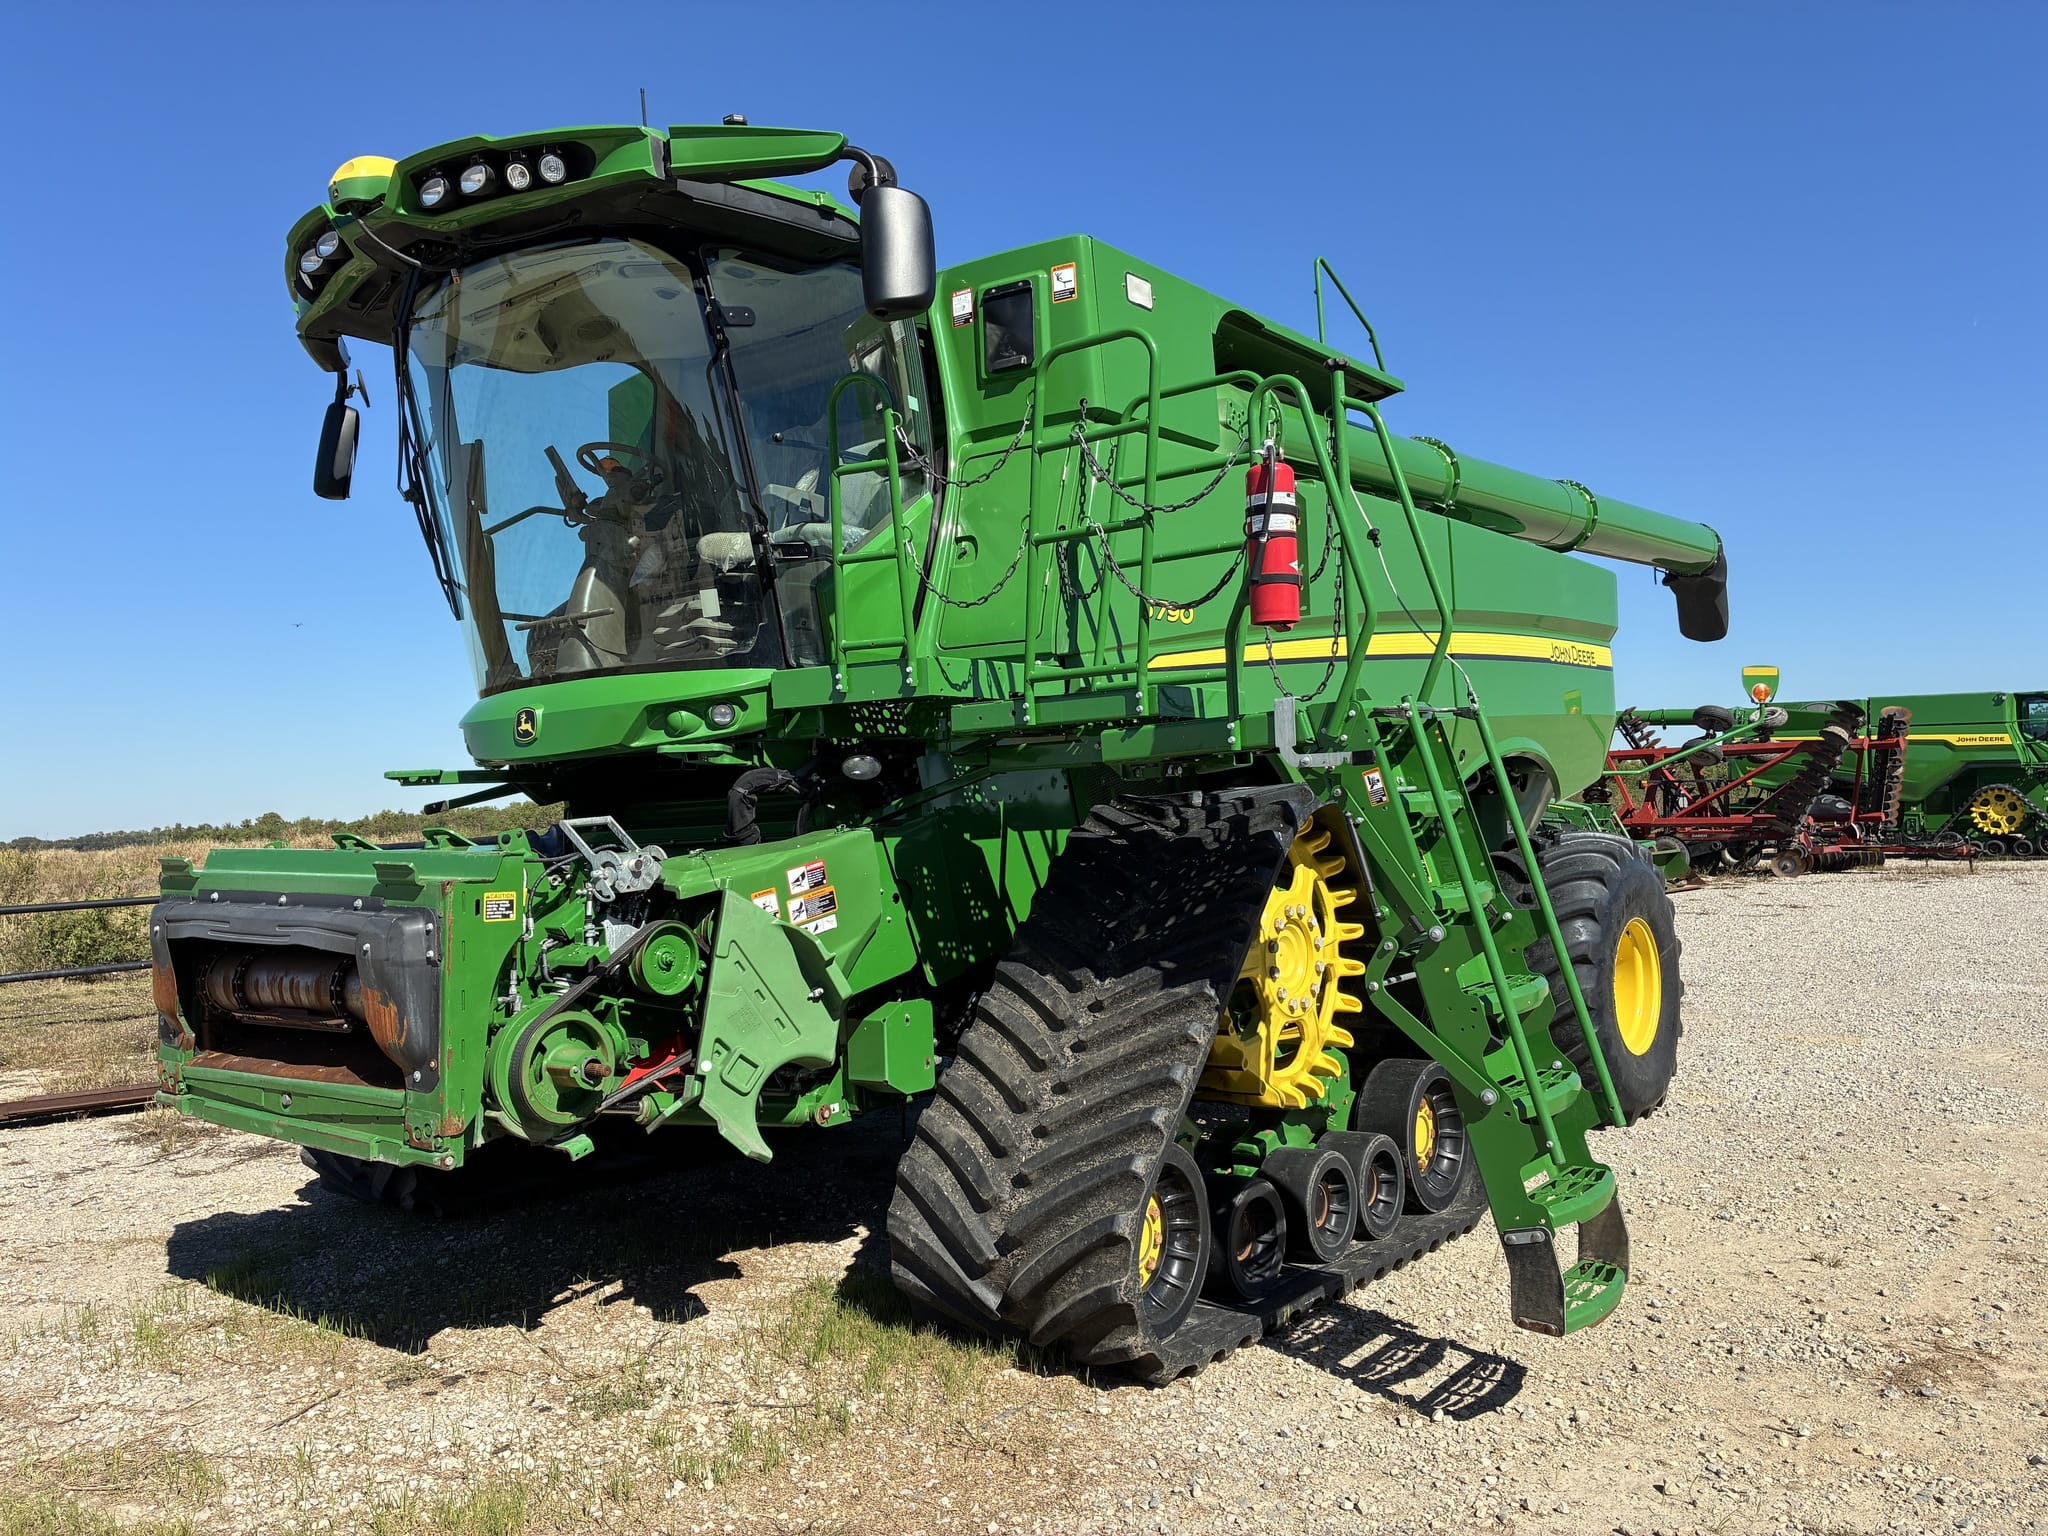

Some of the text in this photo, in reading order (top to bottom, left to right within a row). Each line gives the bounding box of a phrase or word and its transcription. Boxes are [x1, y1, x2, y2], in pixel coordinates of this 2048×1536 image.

[1149, 600, 1194, 625] 790
[1550, 641, 1597, 665] JOHN DEERE
